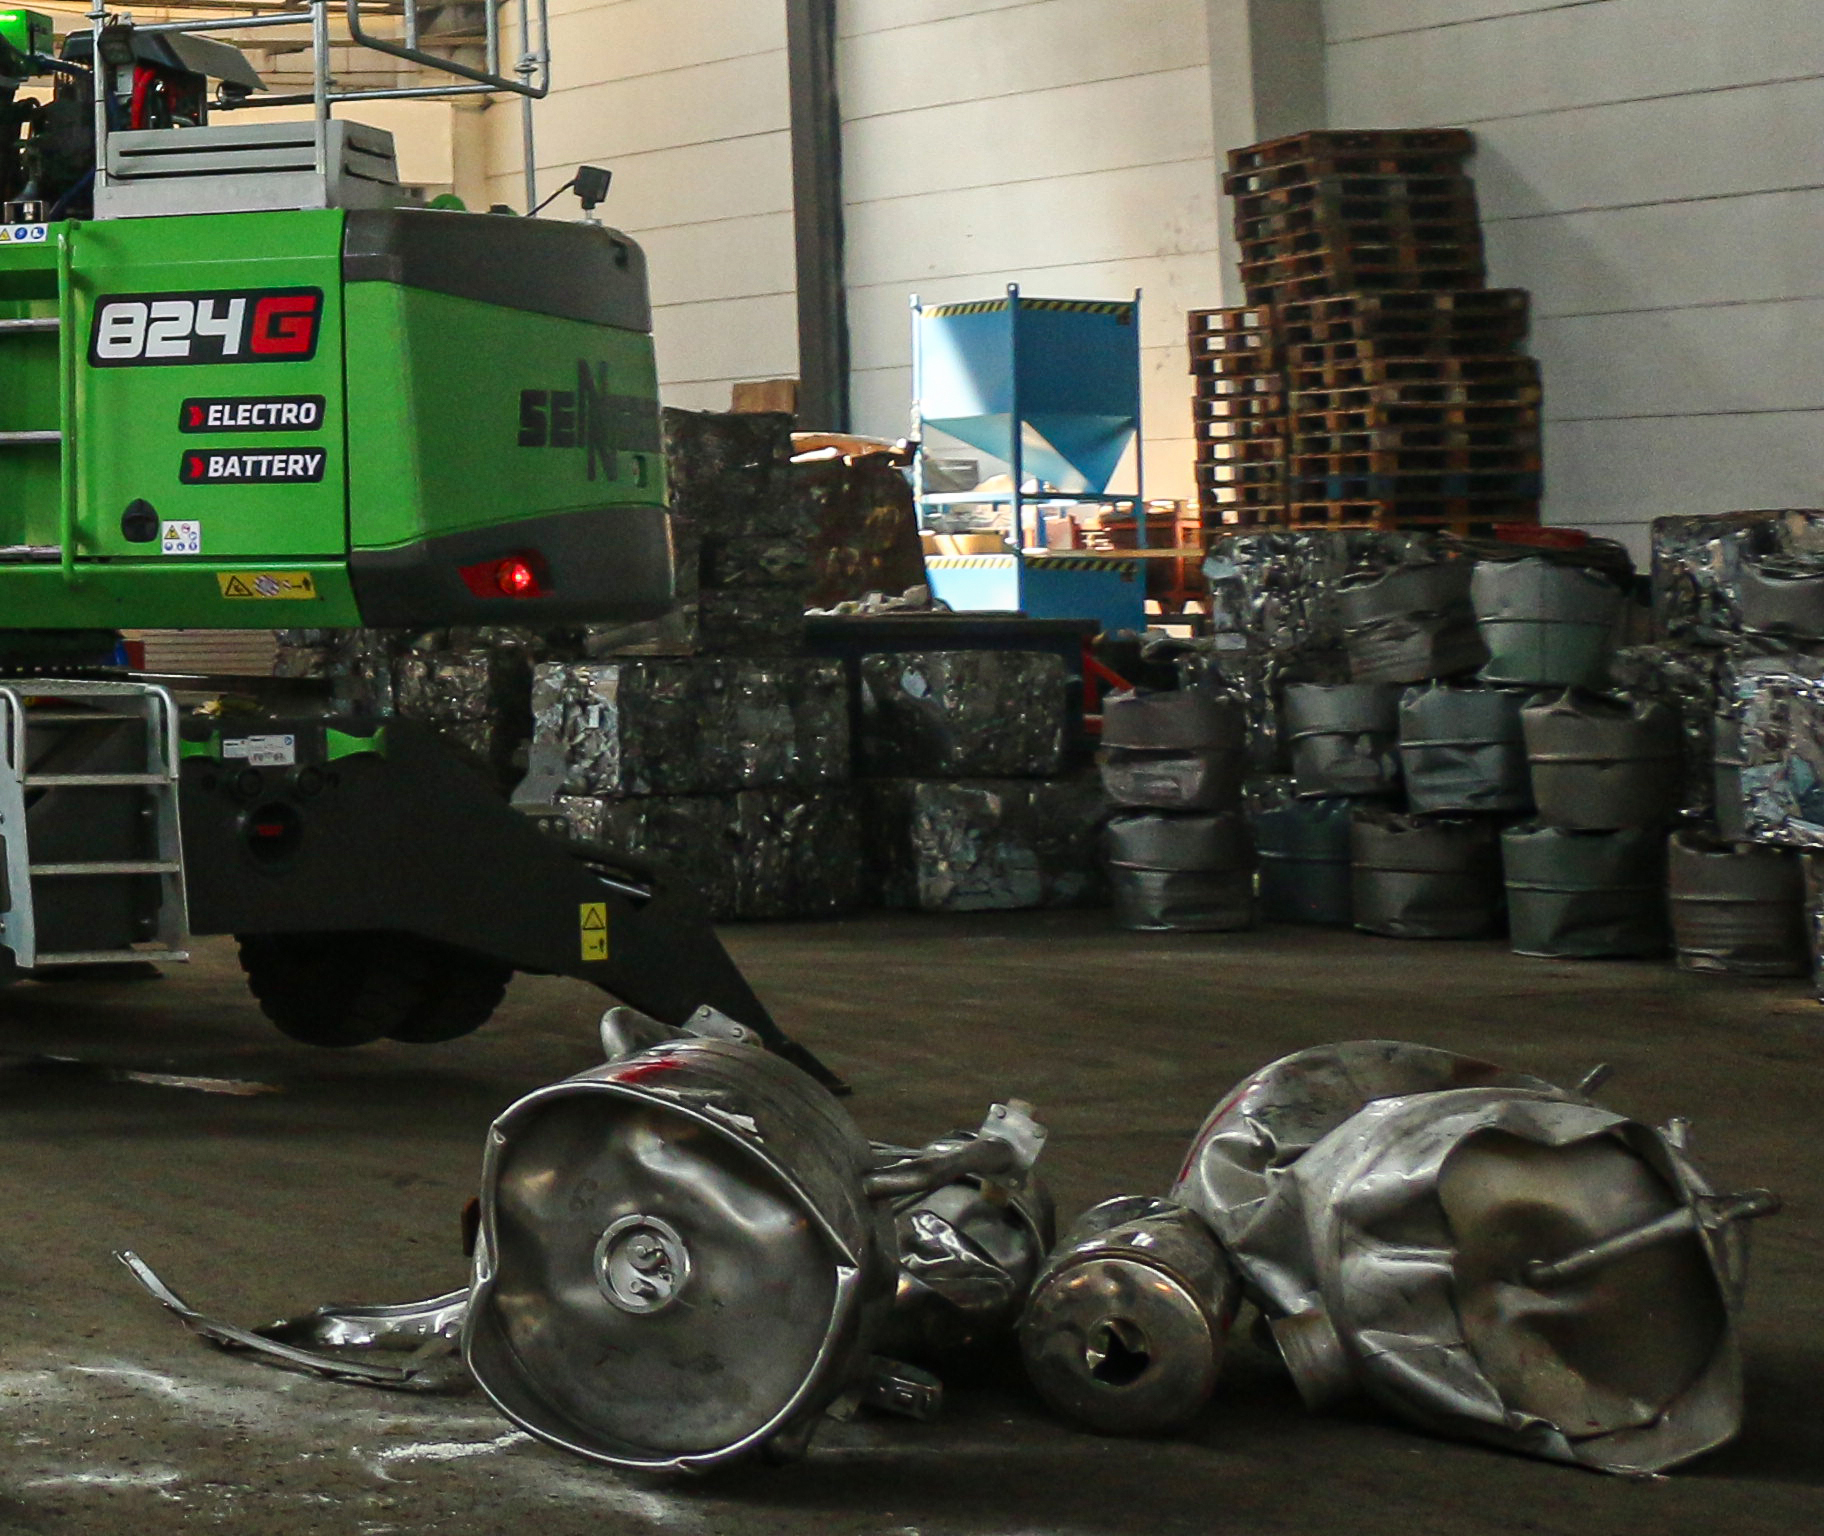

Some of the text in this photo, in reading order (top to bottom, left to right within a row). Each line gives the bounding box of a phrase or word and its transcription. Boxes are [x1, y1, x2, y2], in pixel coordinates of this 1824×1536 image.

[96, 295, 317, 359] 824G
[207, 402, 317, 426] ELECTRO
[207, 453, 322, 478] BATTERY
